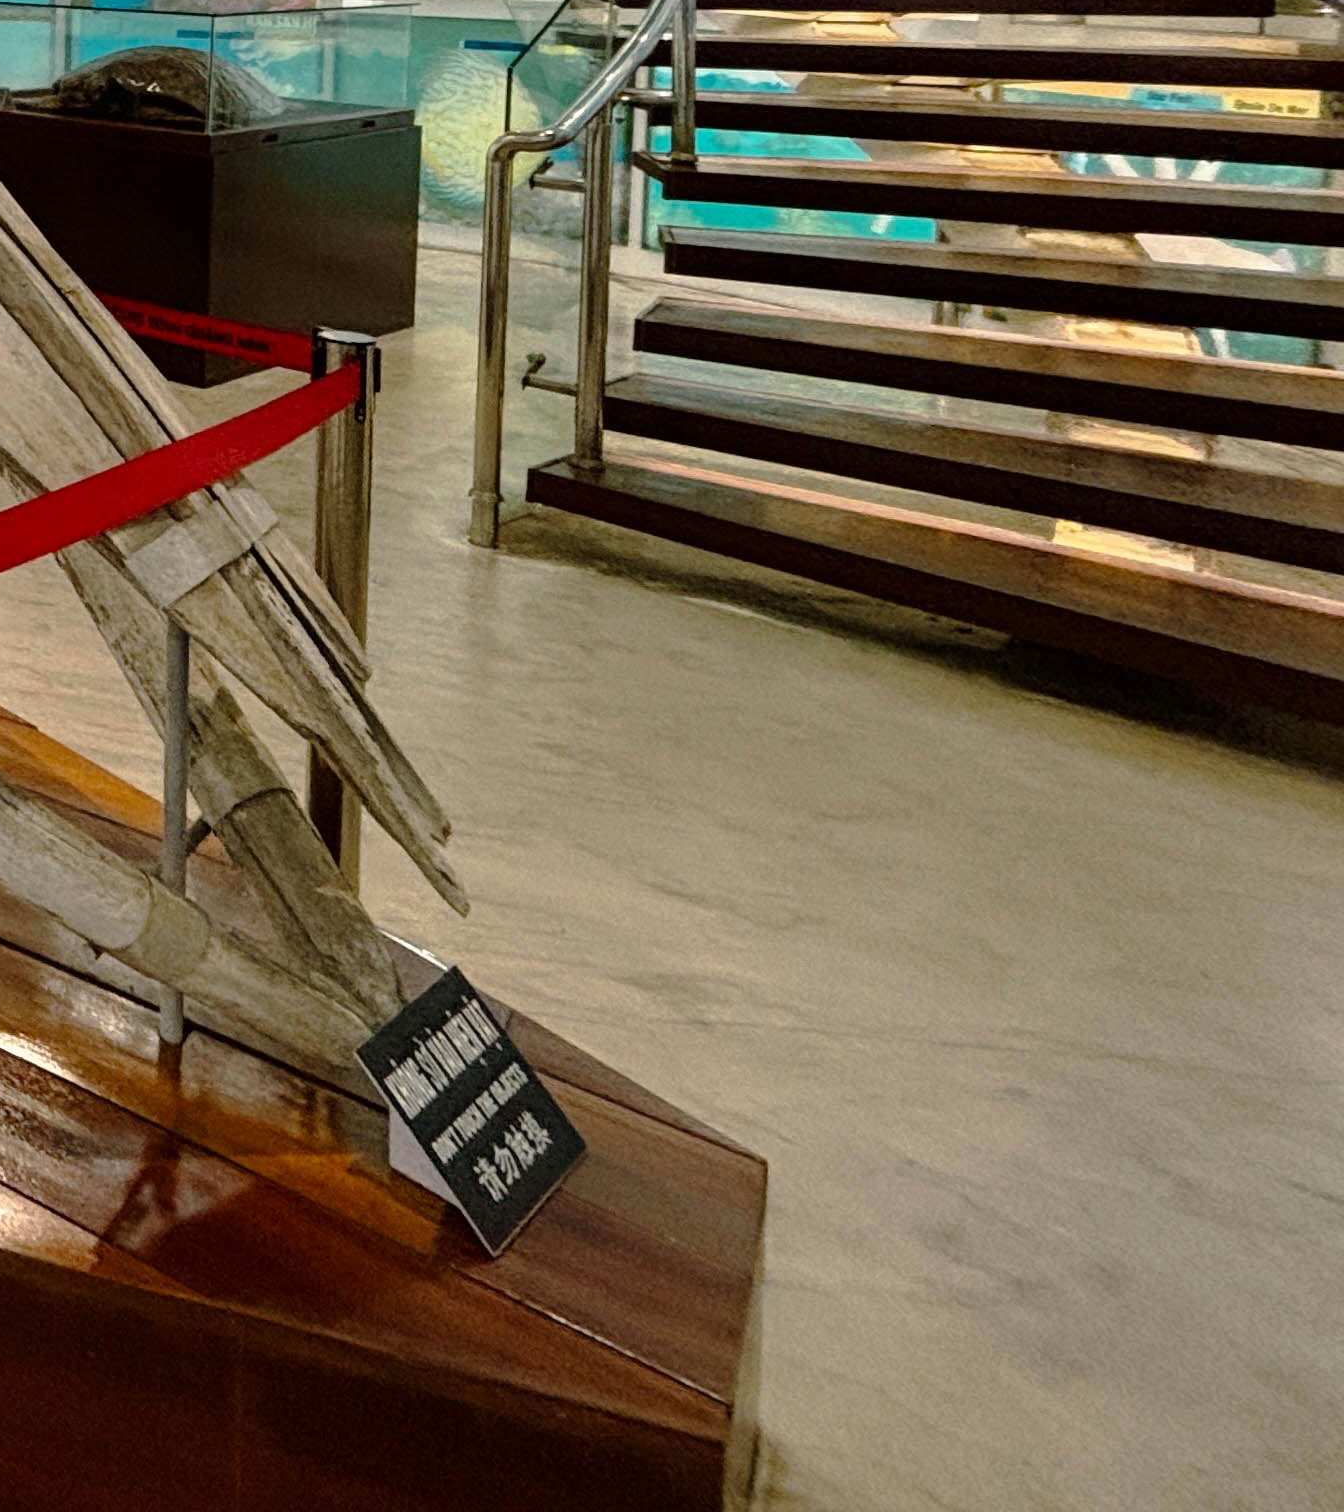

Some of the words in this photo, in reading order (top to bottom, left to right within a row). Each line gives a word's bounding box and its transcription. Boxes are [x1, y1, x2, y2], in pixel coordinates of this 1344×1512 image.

[442, 1009, 488, 1067] HIỆN
[460, 994, 504, 1052] VẬT
[411, 1036, 450, 1092] SỜ
[423, 1027, 466, 1081] VÀO
[383, 1057, 438, 1121] KHÔNG
[474, 1089, 500, 1120] THE
[473, 1111, 553, 1203] 请勿触摸
